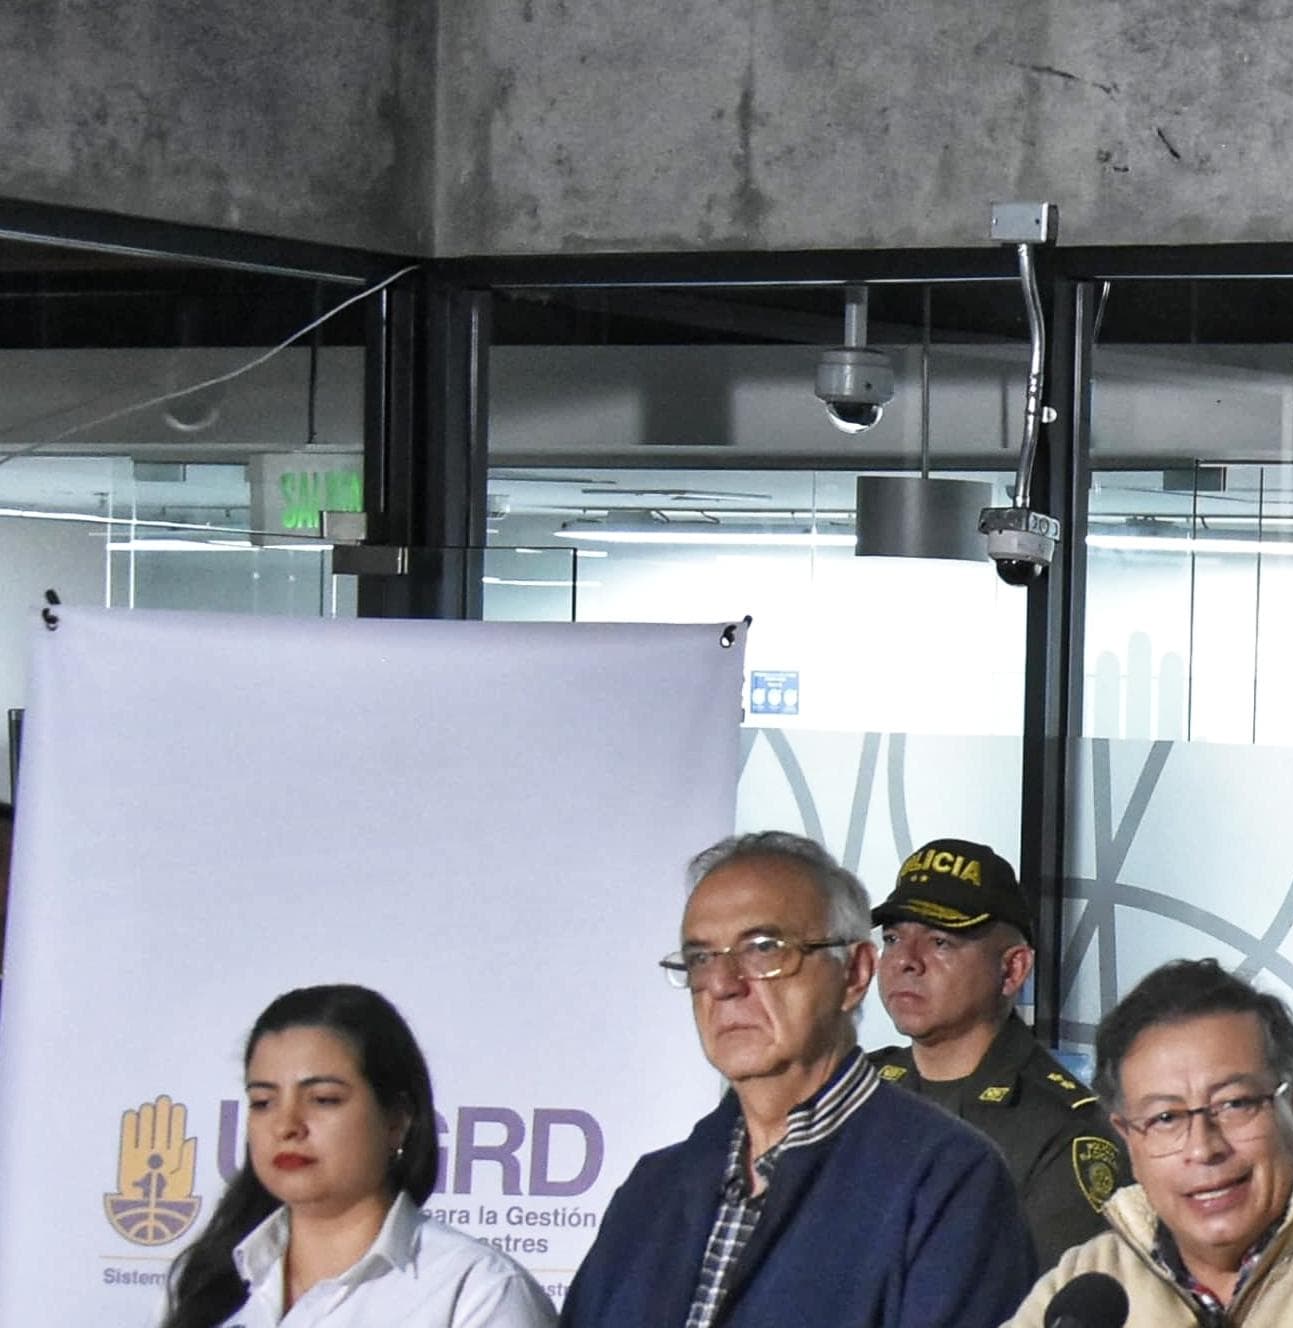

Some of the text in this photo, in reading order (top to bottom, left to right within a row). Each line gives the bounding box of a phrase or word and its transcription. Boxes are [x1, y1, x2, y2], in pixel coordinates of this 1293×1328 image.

[479, 1205, 498, 1225] la
[506, 1204, 597, 1228] Gestión
[103, 1267, 166, 1285] Sistem
